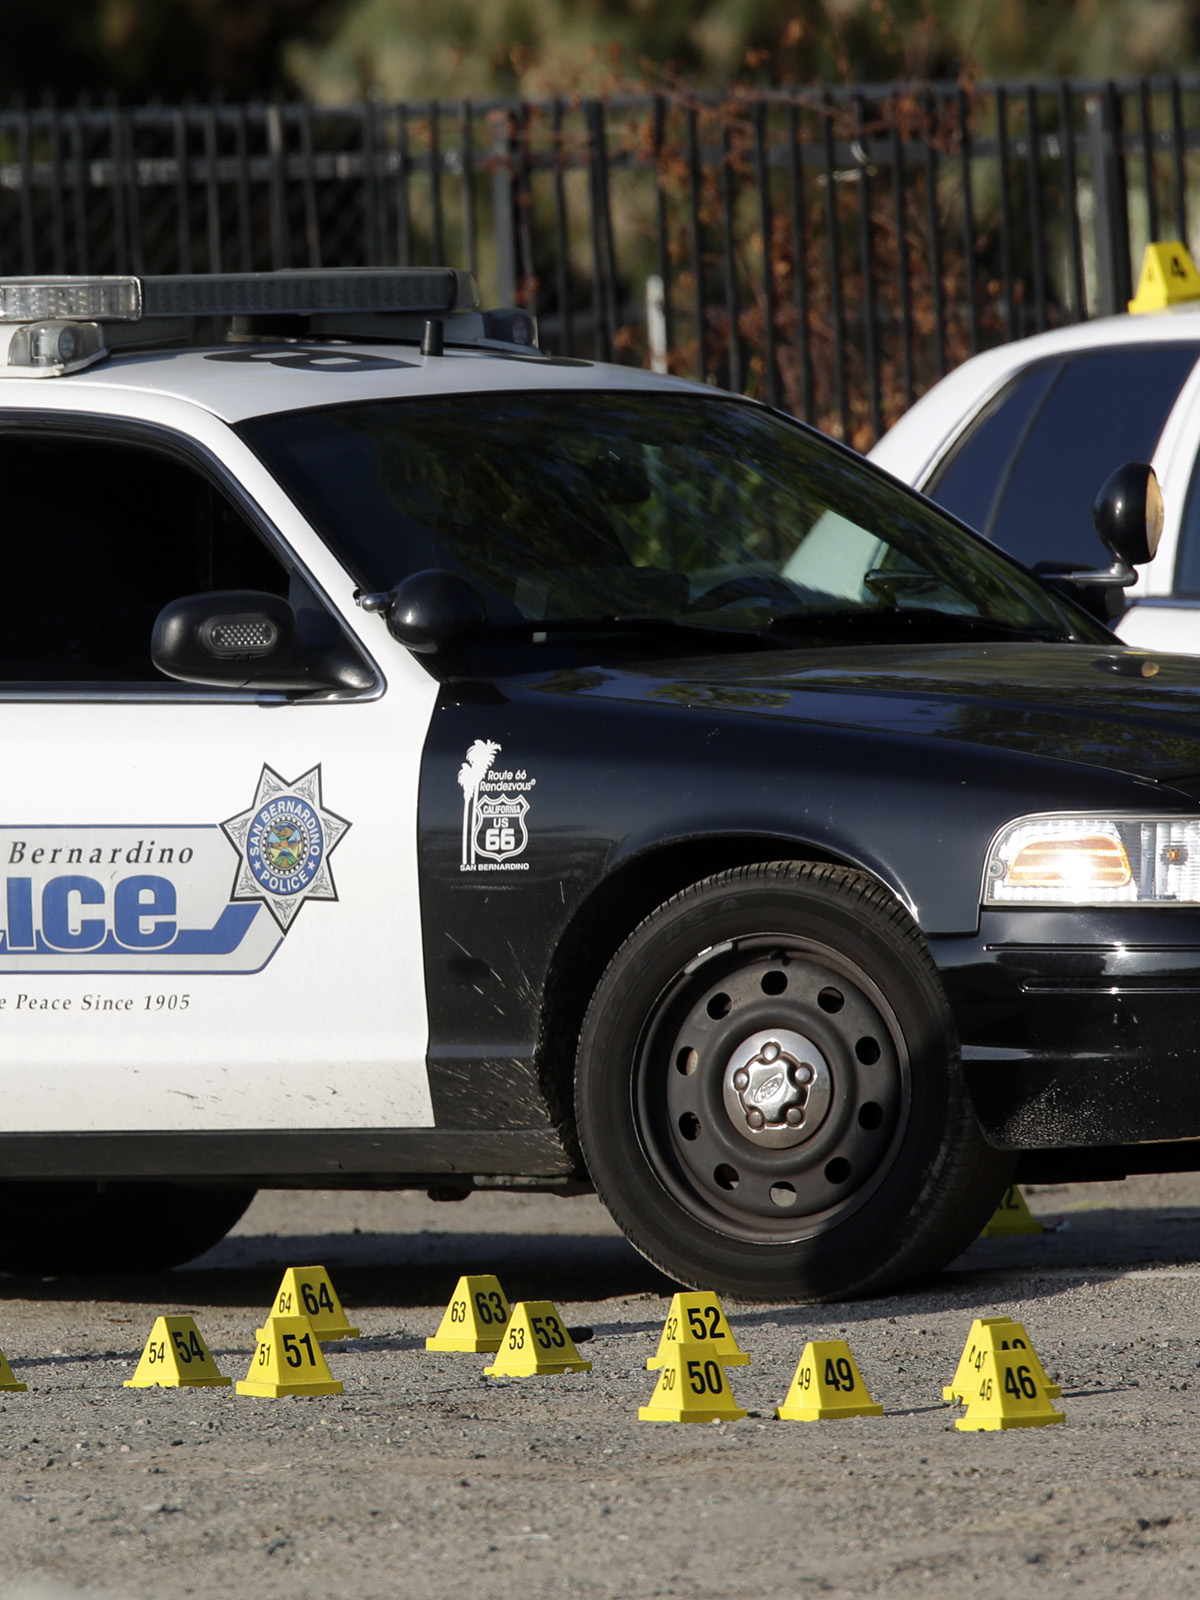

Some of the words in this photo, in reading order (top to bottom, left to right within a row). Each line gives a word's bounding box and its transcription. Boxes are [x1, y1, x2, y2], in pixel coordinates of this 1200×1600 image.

[488, 770, 513, 780] Route
[515, 769, 527, 780] 66
[483, 805, 520, 814] CALIFORNIA
[250, 823, 263, 856] SAN
[260, 801, 321, 857] BERNARDINO
[493, 818, 509, 828] US
[485, 828, 515, 851] 66
[7, 840, 194, 865] Bernardino
[460, 863, 476, 872] SAN
[478, 863, 530, 871] BERNARDINO
[260, 870, 309, 892] POLICE
[15, 993, 72, 1010] Peace
[81, 993, 134, 1011] Since
[143, 994, 191, 1011] 1905
[279, 1292, 292, 1314] 64
[301, 1282, 334, 1315] 64
[475, 1291, 507, 1324] 63
[451, 1301, 466, 1323] 63
[687, 1306, 725, 1340] 52
[509, 1328, 524, 1350] 53
[531, 1316, 565, 1349] 53
[666, 1317, 677, 1340] 52
[149, 1342, 165, 1364] 54
[172, 1331, 205, 1364] 54
[259, 1343, 271, 1367] 51
[282, 1333, 316, 1368] 51
[662, 1368, 676, 1391] 50
[687, 1360, 723, 1395] 50
[797, 1367, 811, 1390] 49
[825, 1357, 855, 1392] 49
[1005, 1365, 1037, 1400] 46
[979, 1378, 992, 1401] 46
